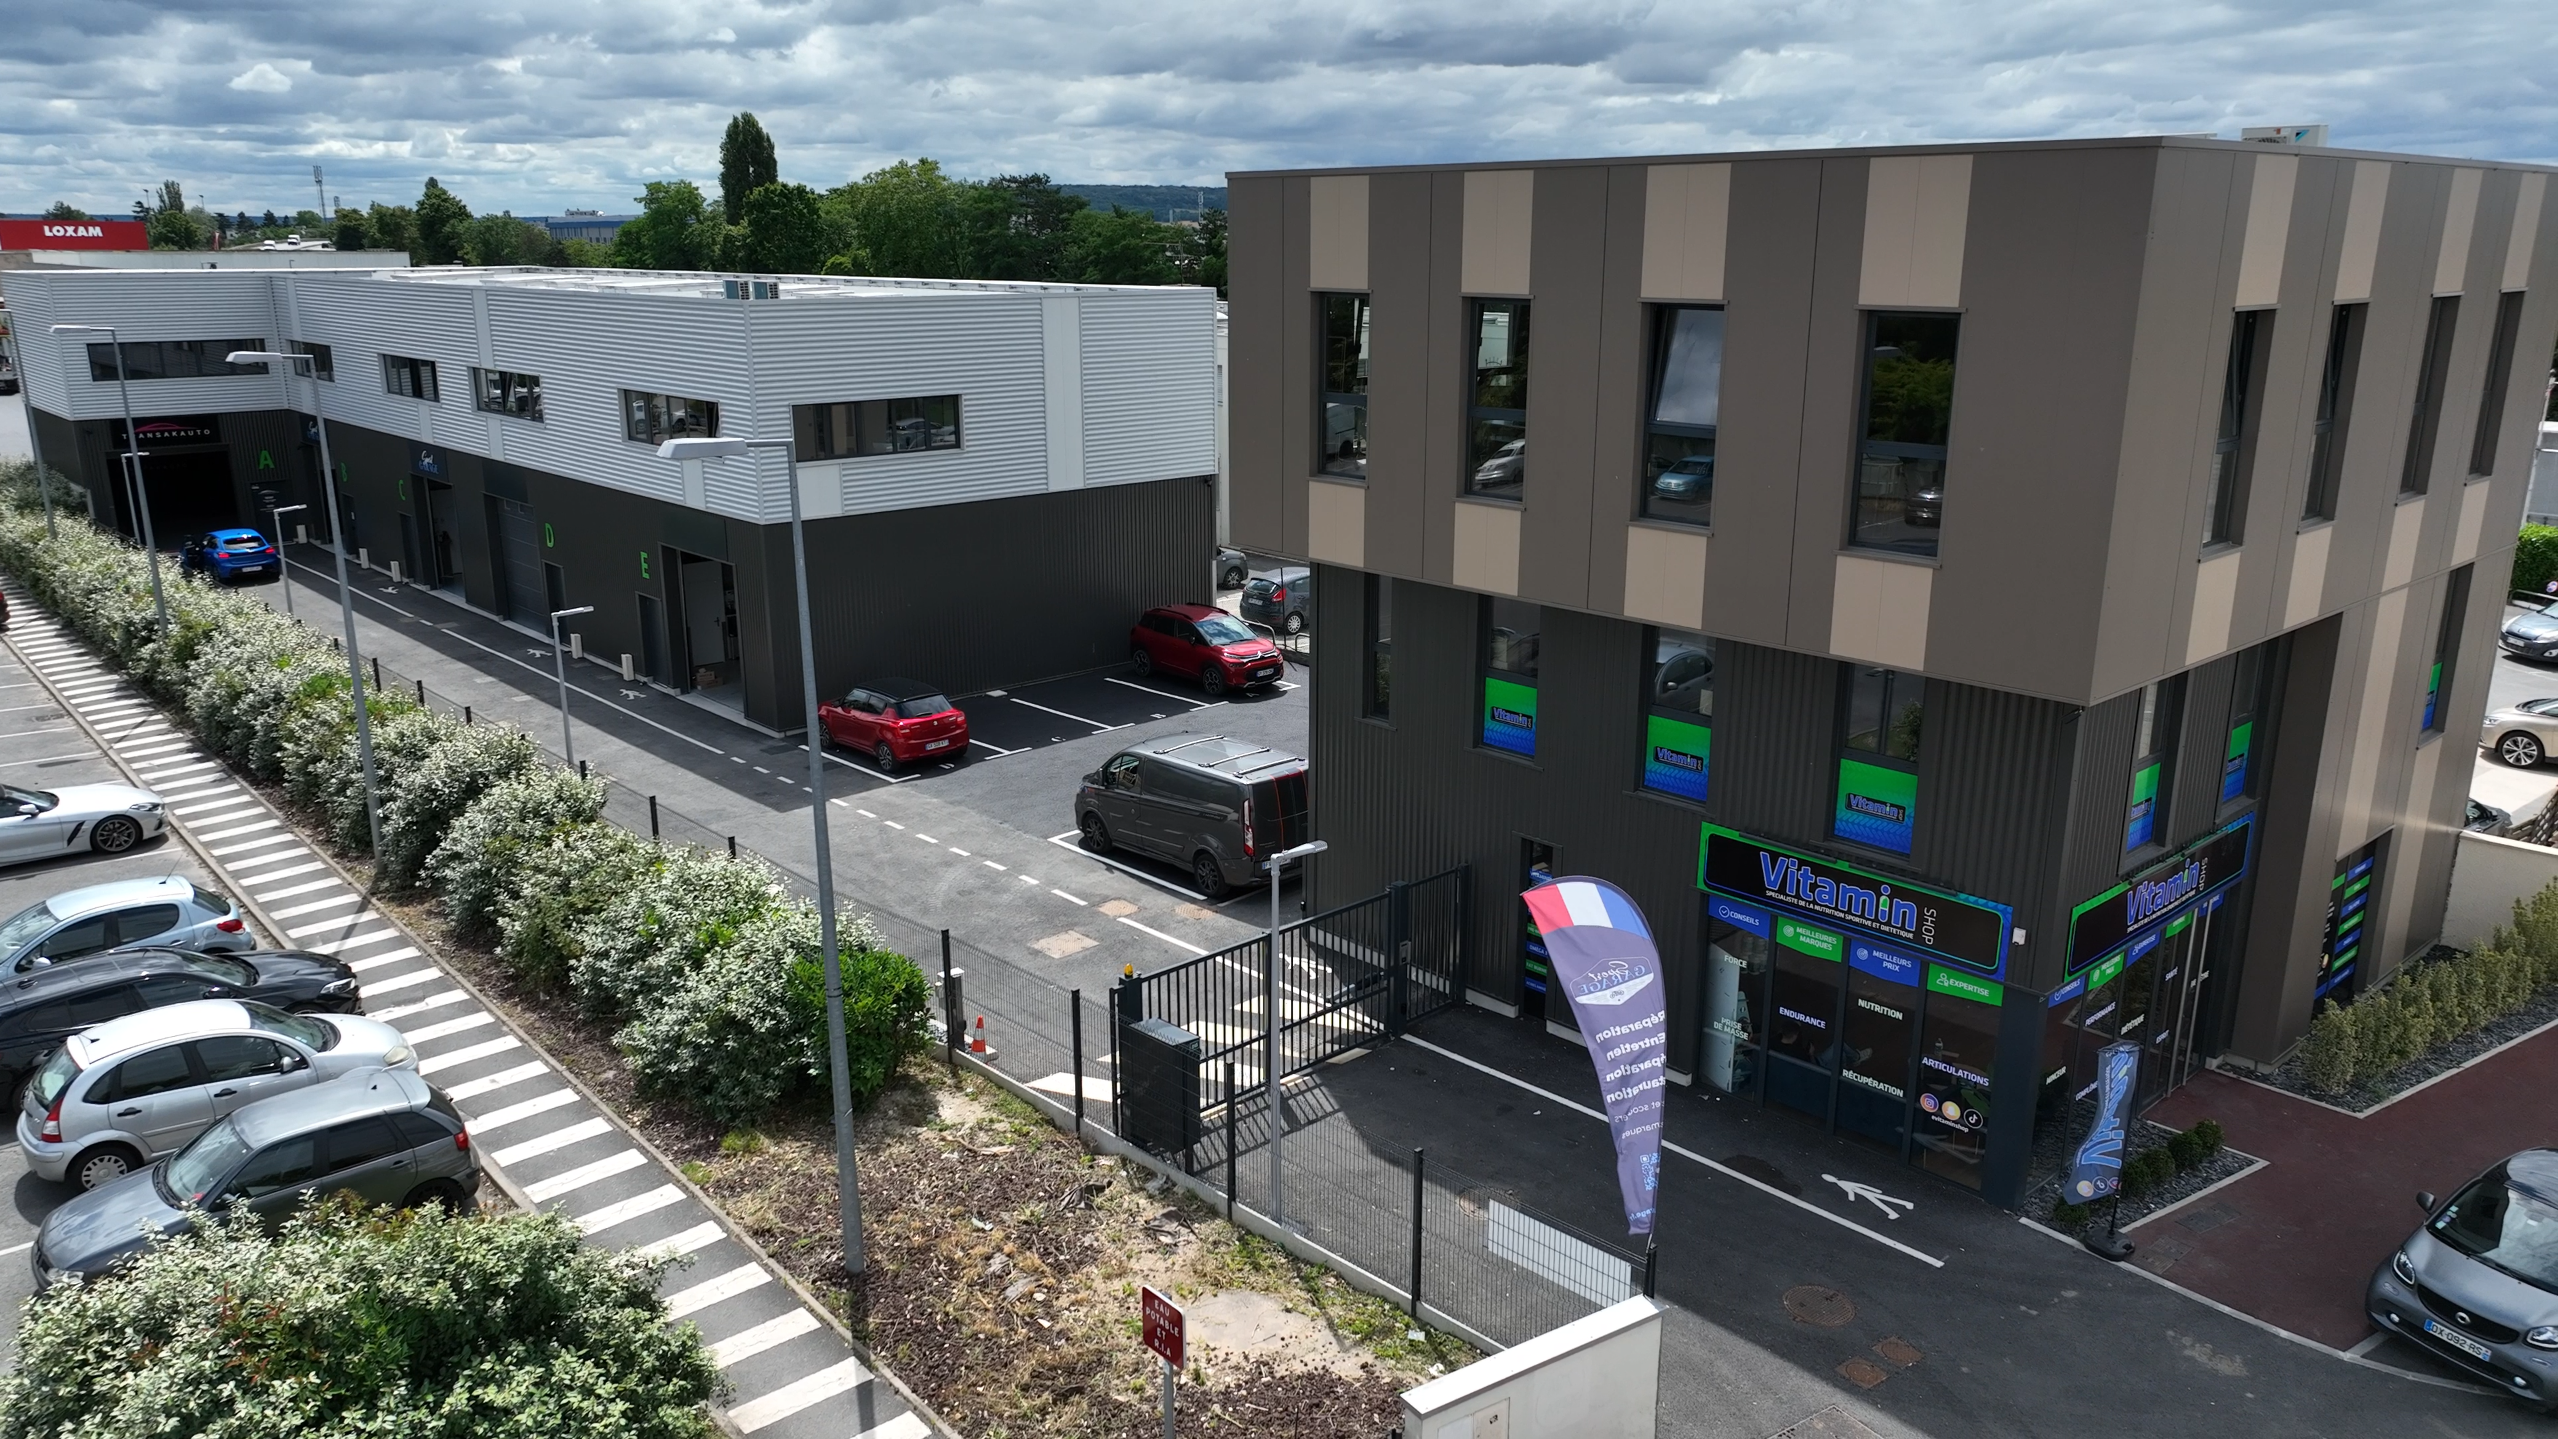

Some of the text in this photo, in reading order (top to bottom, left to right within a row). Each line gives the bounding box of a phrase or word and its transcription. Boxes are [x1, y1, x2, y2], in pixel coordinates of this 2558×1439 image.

[43, 225, 103, 237] LOXAM
[121, 429, 211, 440] TANSAKAUTO
[258, 450, 275, 470] A
[340, 462, 348, 482] B
[398, 479, 406, 501] C
[545, 523, 555, 548] D
[640, 551, 650, 580] E
[1493, 706, 1528, 726] Vitamin
[1656, 746, 1698, 768] Vitamin
[1849, 793, 1899, 817] Vitamin
[2199, 857, 2208, 891] SHOP
[1759, 851, 1917, 932] Vitamin
[2126, 857, 2200, 926] Vitamin
[1729, 911, 1760, 926] CONSEILS
[1765, 890, 1798, 905] SPECIALISTE
[1814, 904, 1845, 918] NUTRITION
[1845, 913, 1872, 928] SPORTIVE
[1872, 921, 1880, 929] ET
[1796, 926, 1837, 945] MEILLEURES
[1922, 907, 1937, 945] SHOP
[1799, 935, 1833, 951] MARQUES
[1723, 954, 1748, 969] FORCE
[1872, 950, 1912, 968] MEILLEURS
[1882, 961, 1900, 973] PRIX
[1949, 978, 1990, 997] EXPERTISE
[1779, 1006, 1826, 1029] ENDURANCE
[1857, 998, 1904, 1021] NUTRITION
[1713, 1021, 1749, 1041] DE MASSE
[1721, 1016, 1742, 1031] PRISE
[1921, 1056, 1990, 1087] ARTICULATIONS
[1842, 1068, 1904, 1098] RÉCUPÉRATION
[1931, 1114, 1969, 1133] evitaminshop
[1154, 1299, 1170, 1318] EAU
[1145, 1306, 1180, 1338] POTABLE
[1156, 1327, 1167, 1341] ET
[2431, 1323, 2484, 1356] DX-092-RS
[1154, 1339, 1172, 1358] R.I.A
